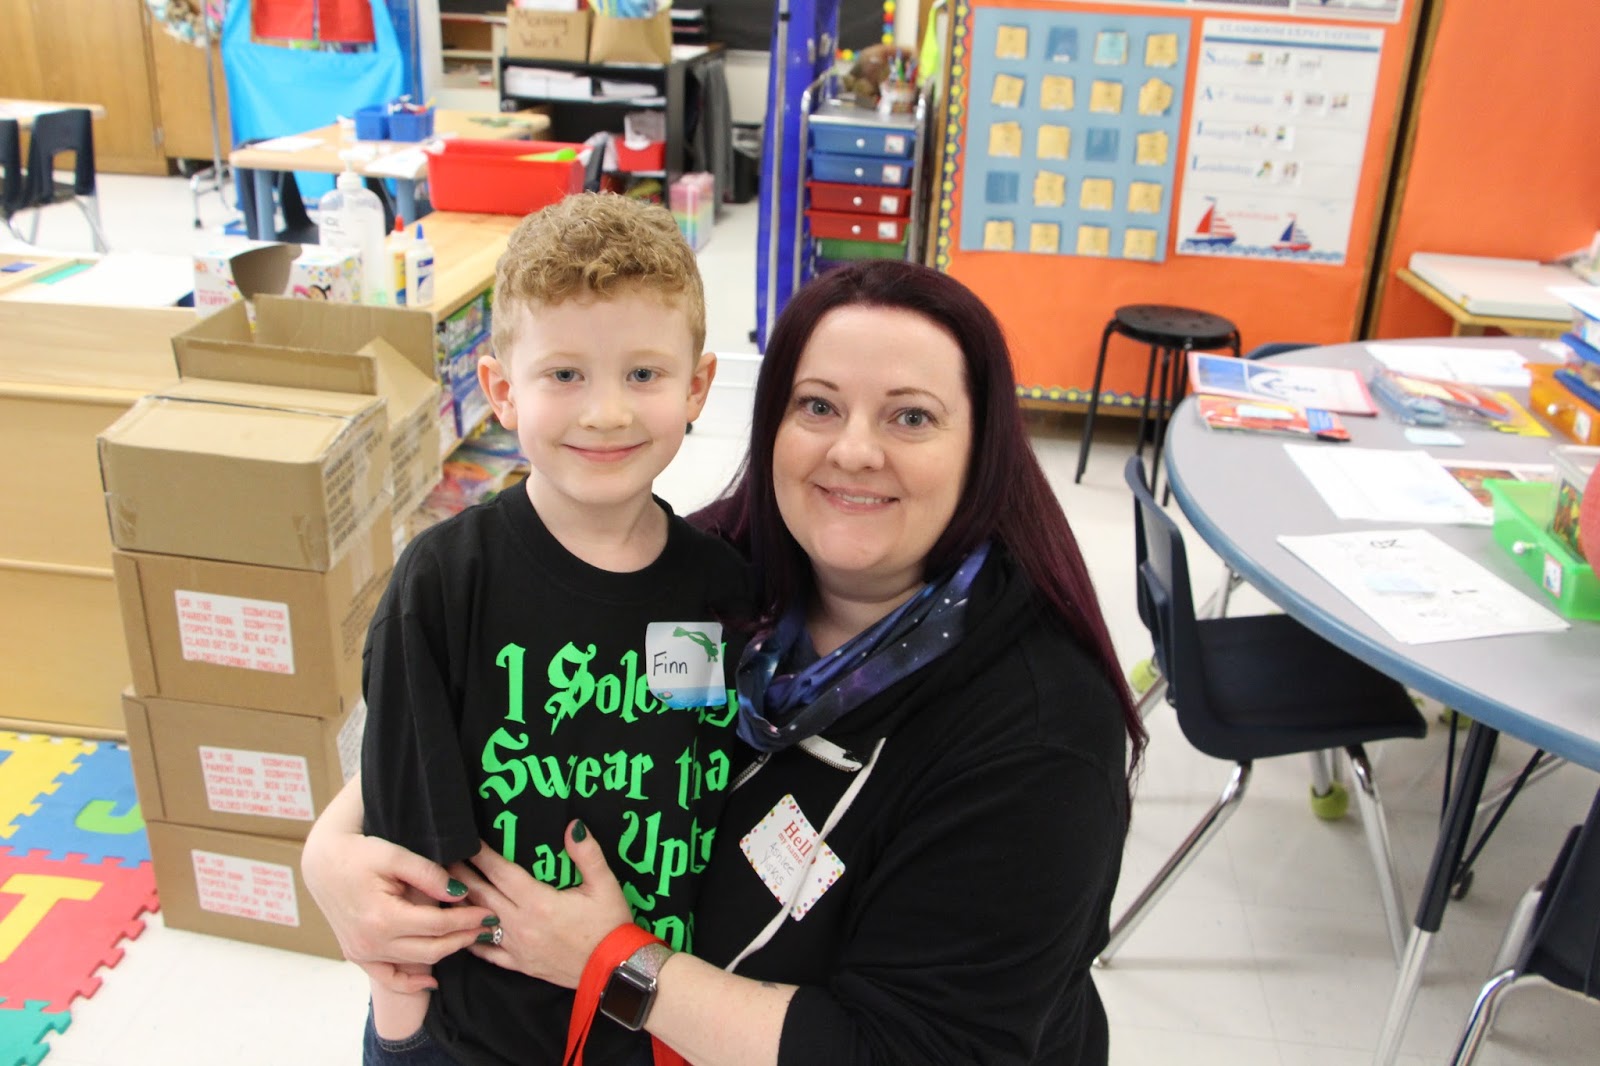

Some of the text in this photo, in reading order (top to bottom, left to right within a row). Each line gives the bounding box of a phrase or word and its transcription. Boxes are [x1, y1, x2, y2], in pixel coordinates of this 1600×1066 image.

[519, 32, 562, 50] Work
[496, 642, 526, 725] I
[653, 651, 688, 677] Finn
[478, 727, 730, 810] Swear tha
